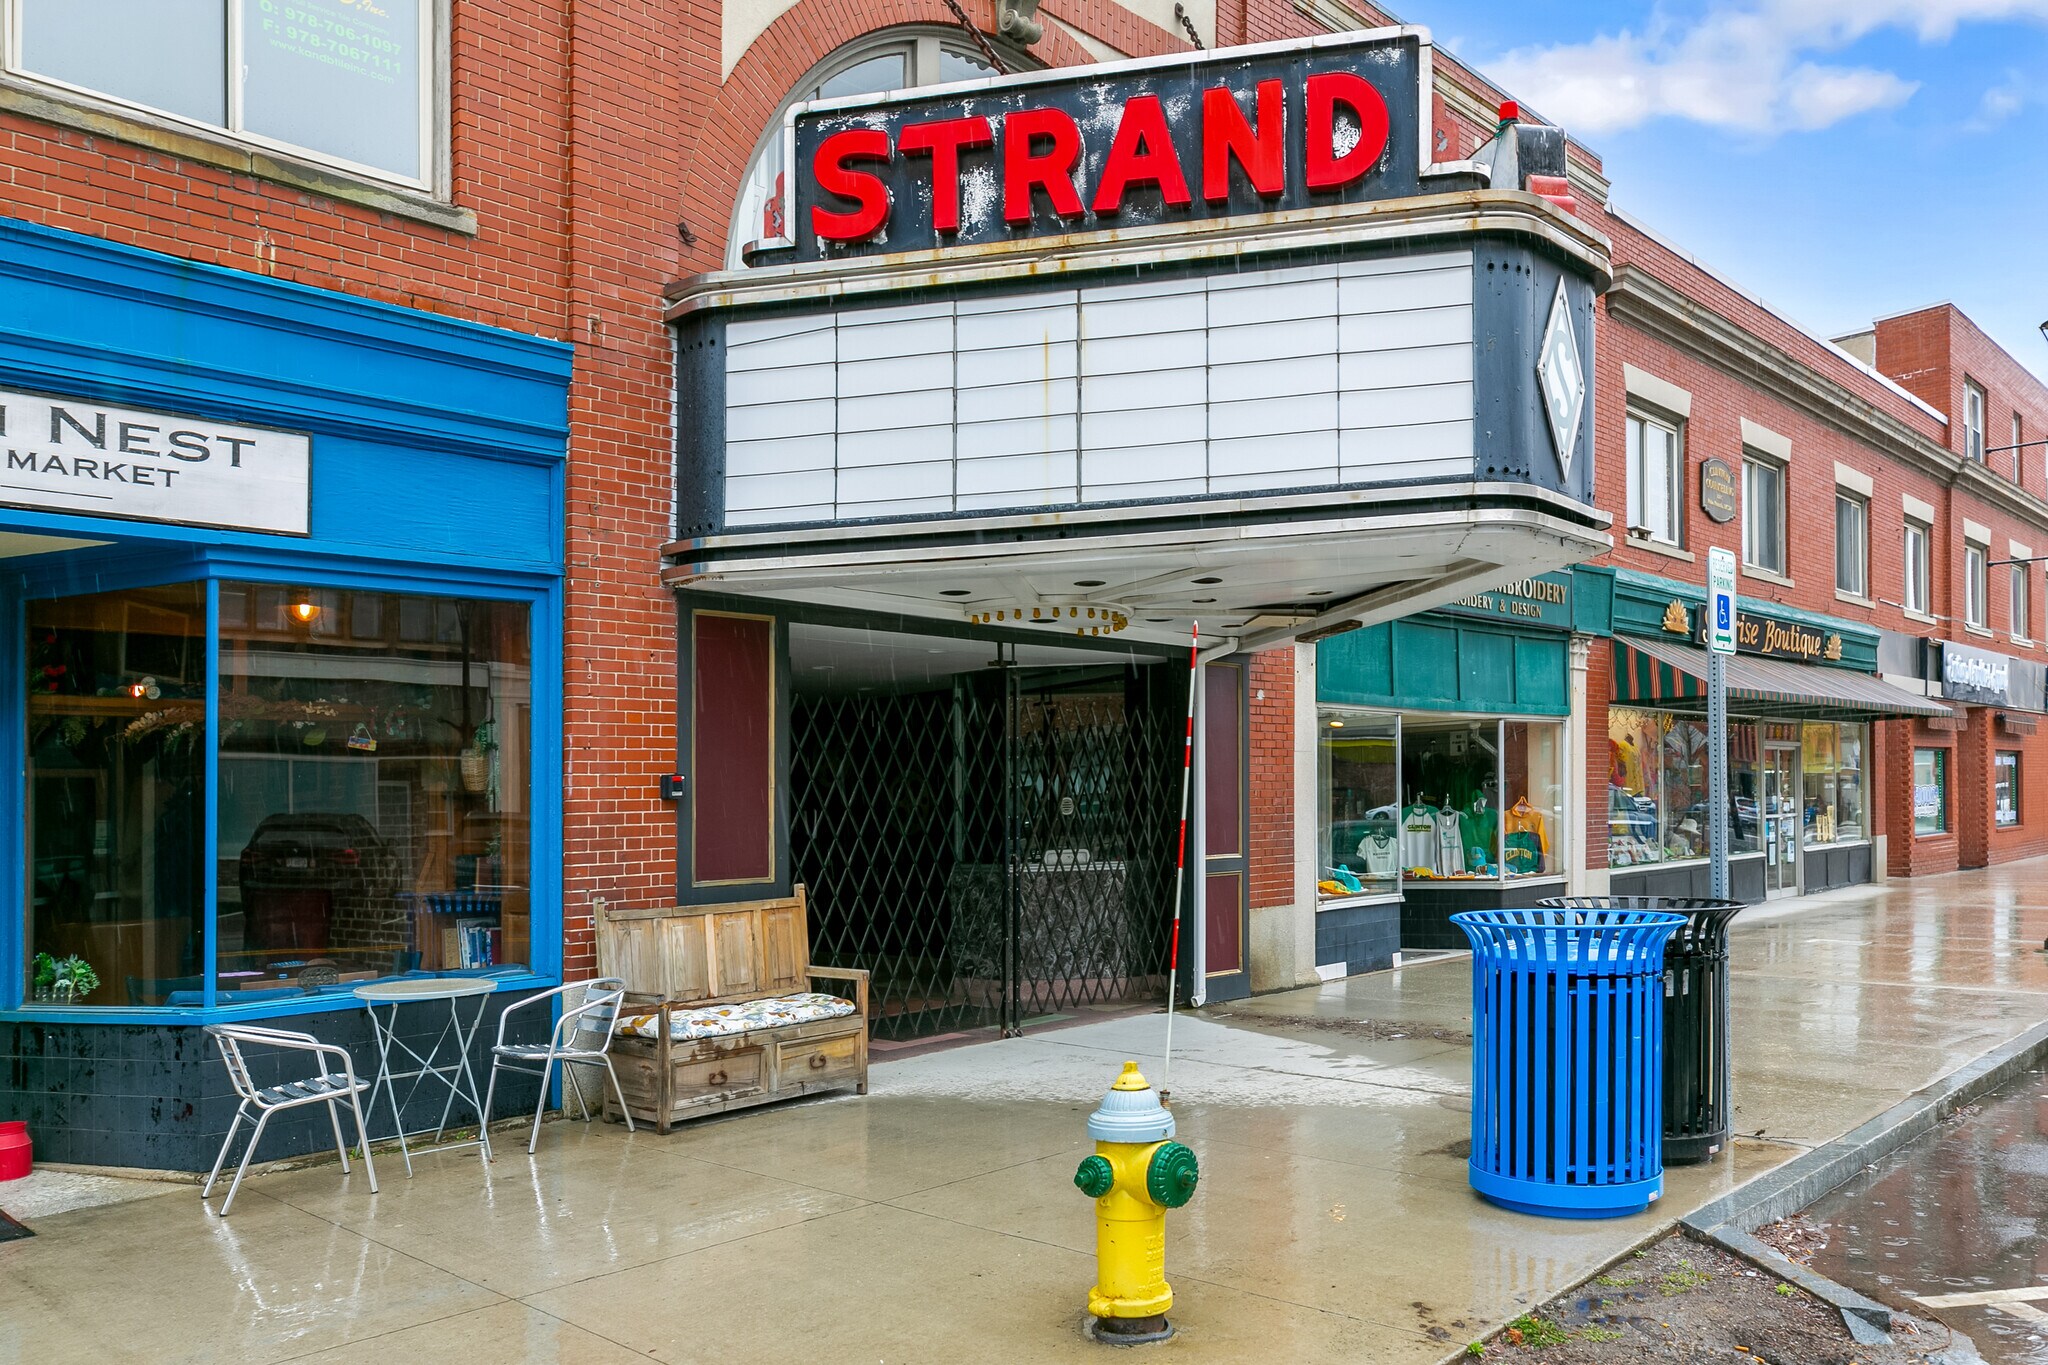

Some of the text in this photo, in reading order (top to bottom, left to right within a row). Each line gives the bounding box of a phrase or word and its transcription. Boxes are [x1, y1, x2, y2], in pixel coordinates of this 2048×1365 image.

[263, 17, 401, 74] F: 978-7067111
[284, 6, 401, 55] 978-706-1097
[811, 71, 1391, 243] STRAND
[49, 405, 256, 468] NEST
[7, 448, 180, 488] MARKET
[1492, 578, 1568, 605] BROIDERY
[1713, 575, 1733, 592] PARKING
[1499, 599, 1507, 612] &
[1512, 601, 1542, 618] DESIGN
[1762, 620, 1821, 660] Boutique
[1505, 848, 1533, 861] CLINTON
